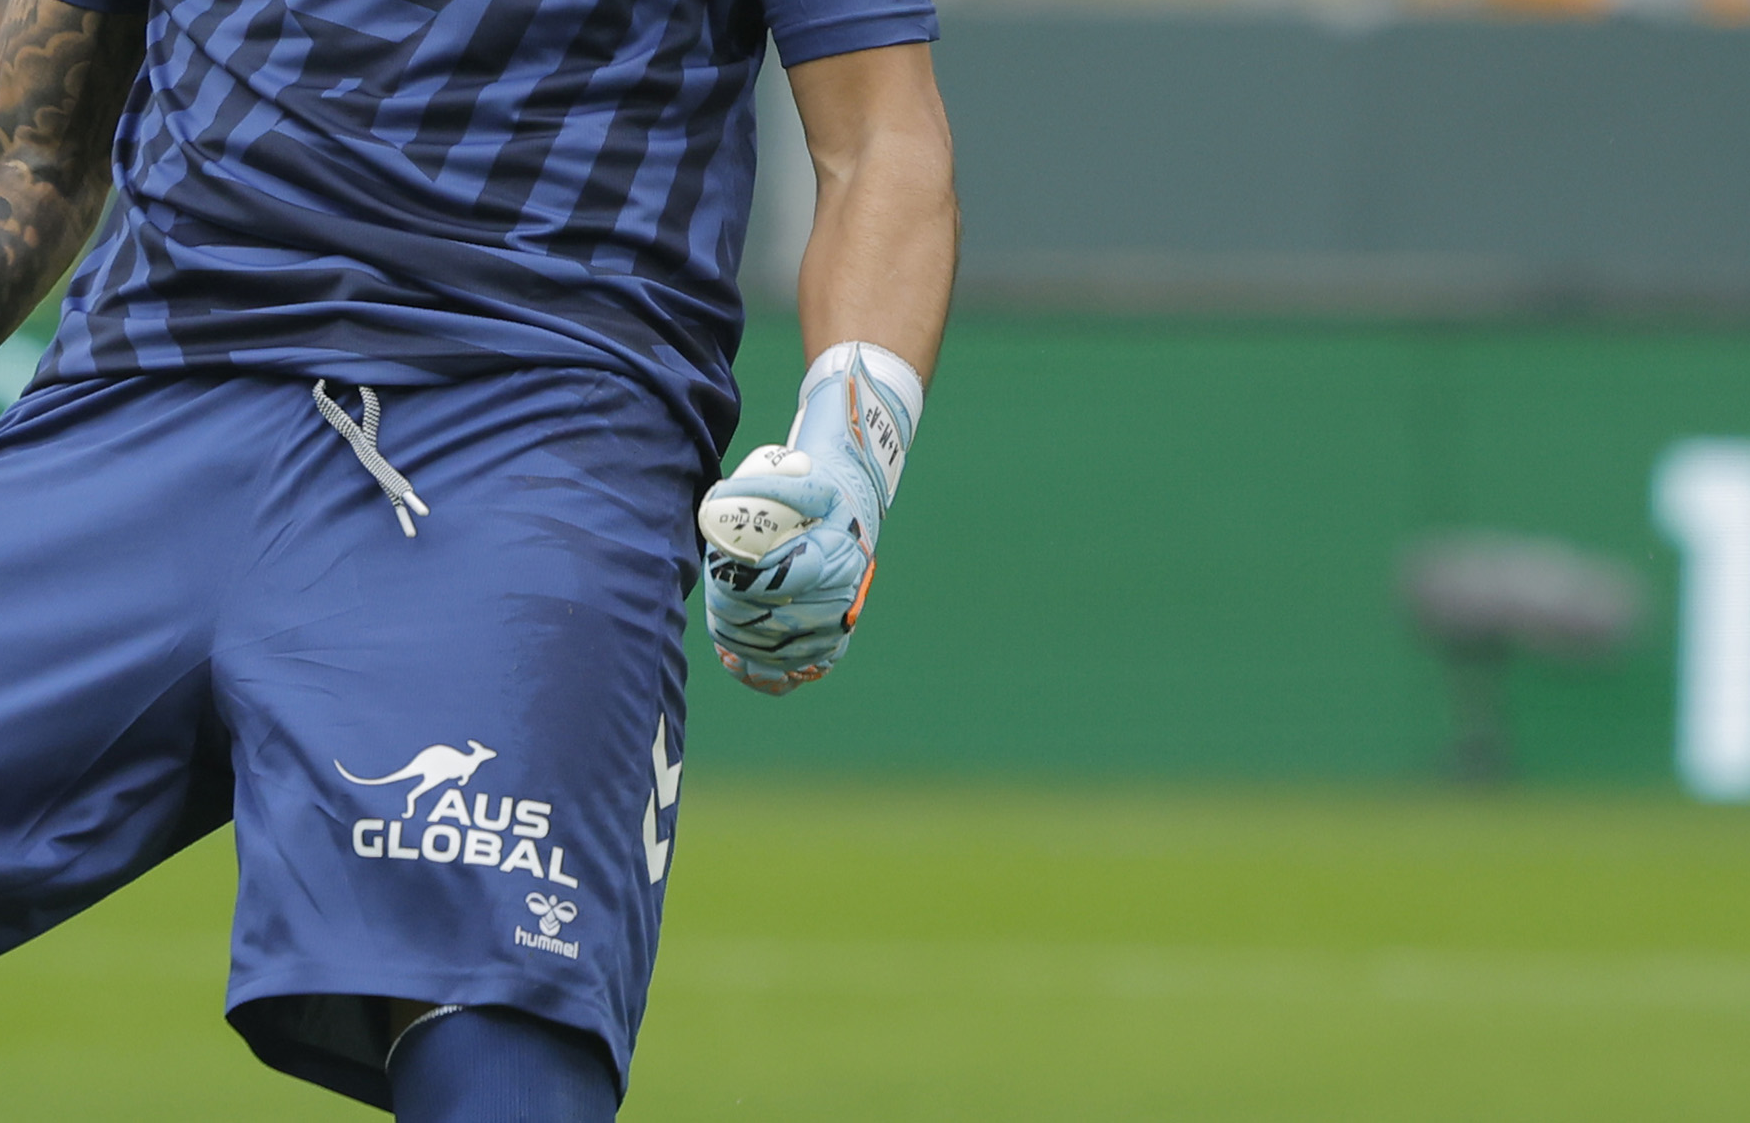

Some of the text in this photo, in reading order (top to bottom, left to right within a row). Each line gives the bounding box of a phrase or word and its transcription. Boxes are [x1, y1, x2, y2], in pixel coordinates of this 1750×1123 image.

[427, 788, 552, 839] AUS
[352, 818, 578, 889] GLOBAL
[515, 925, 580, 960] hummel
